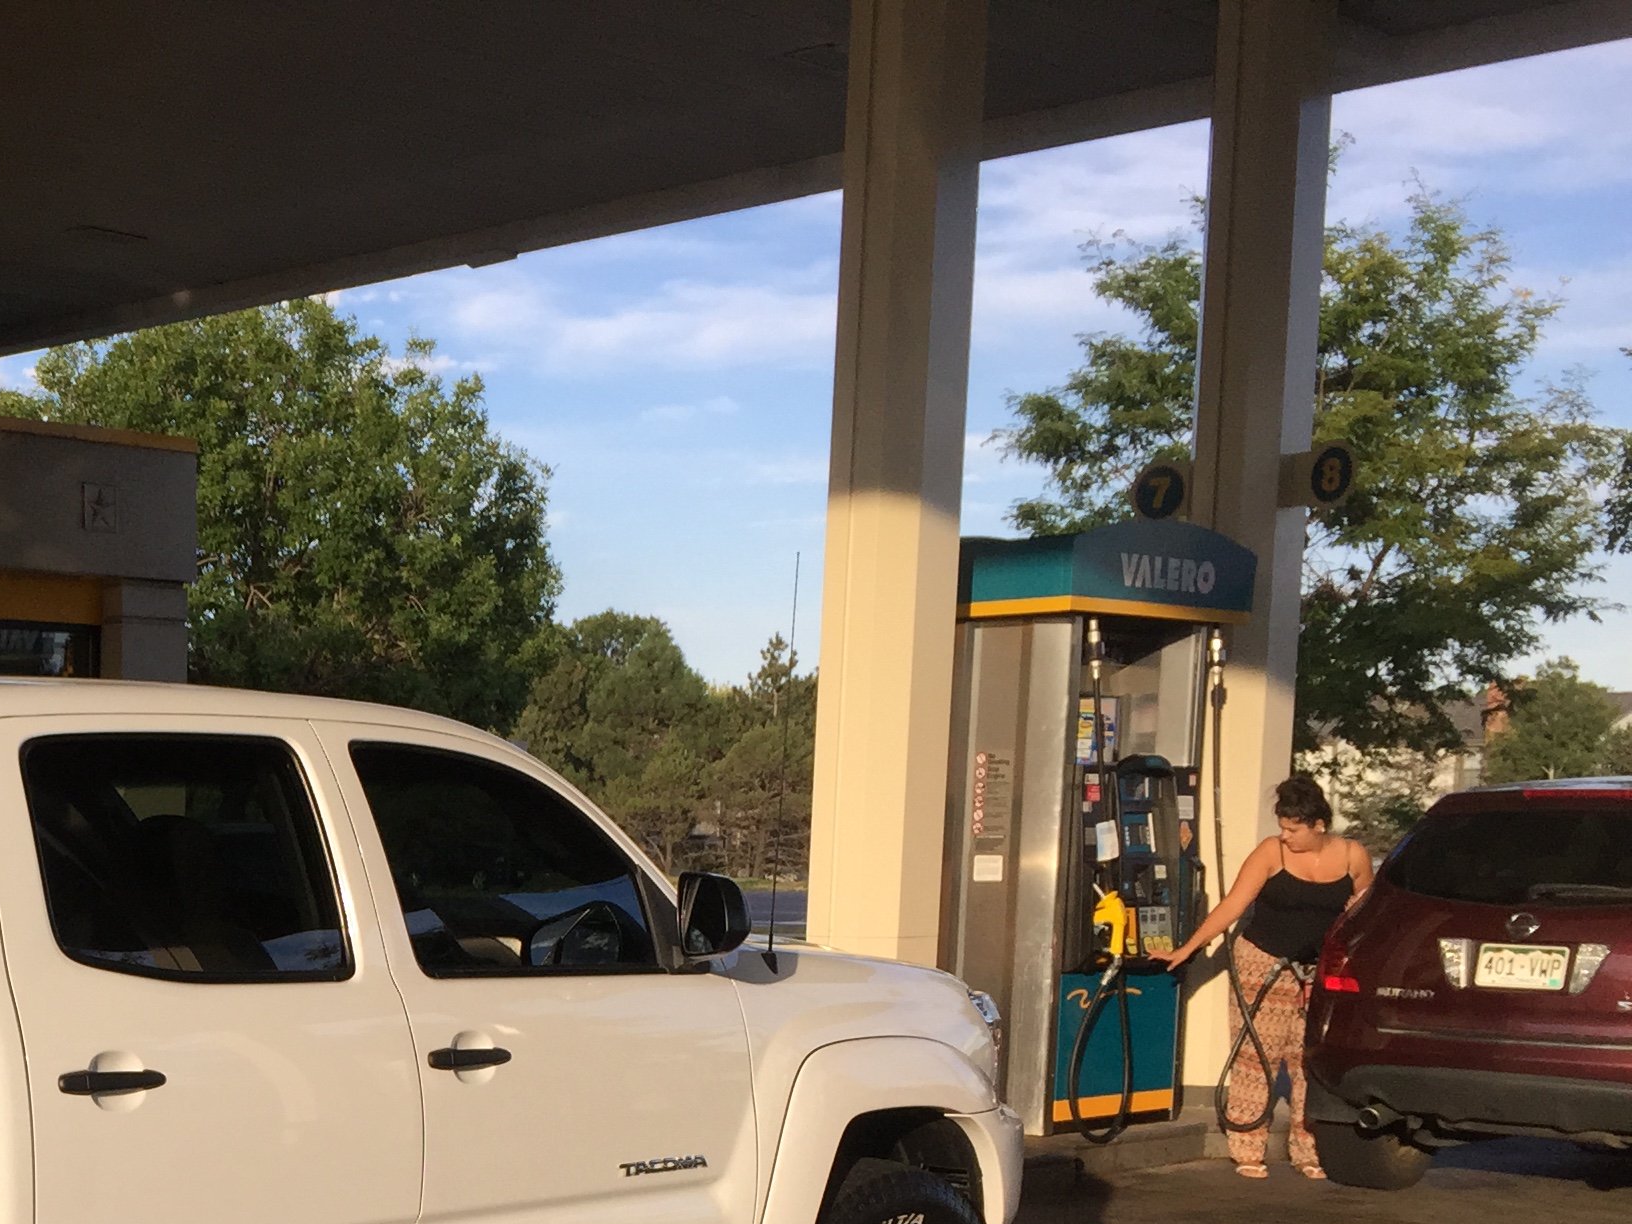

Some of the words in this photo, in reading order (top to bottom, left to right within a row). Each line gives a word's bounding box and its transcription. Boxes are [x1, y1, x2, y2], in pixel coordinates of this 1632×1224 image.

[1320, 459, 1342, 490] 8
[1148, 476, 1172, 510] 7
[1120, 552, 1216, 594] VALERO
[618, 1154, 708, 1178] TACOMA
